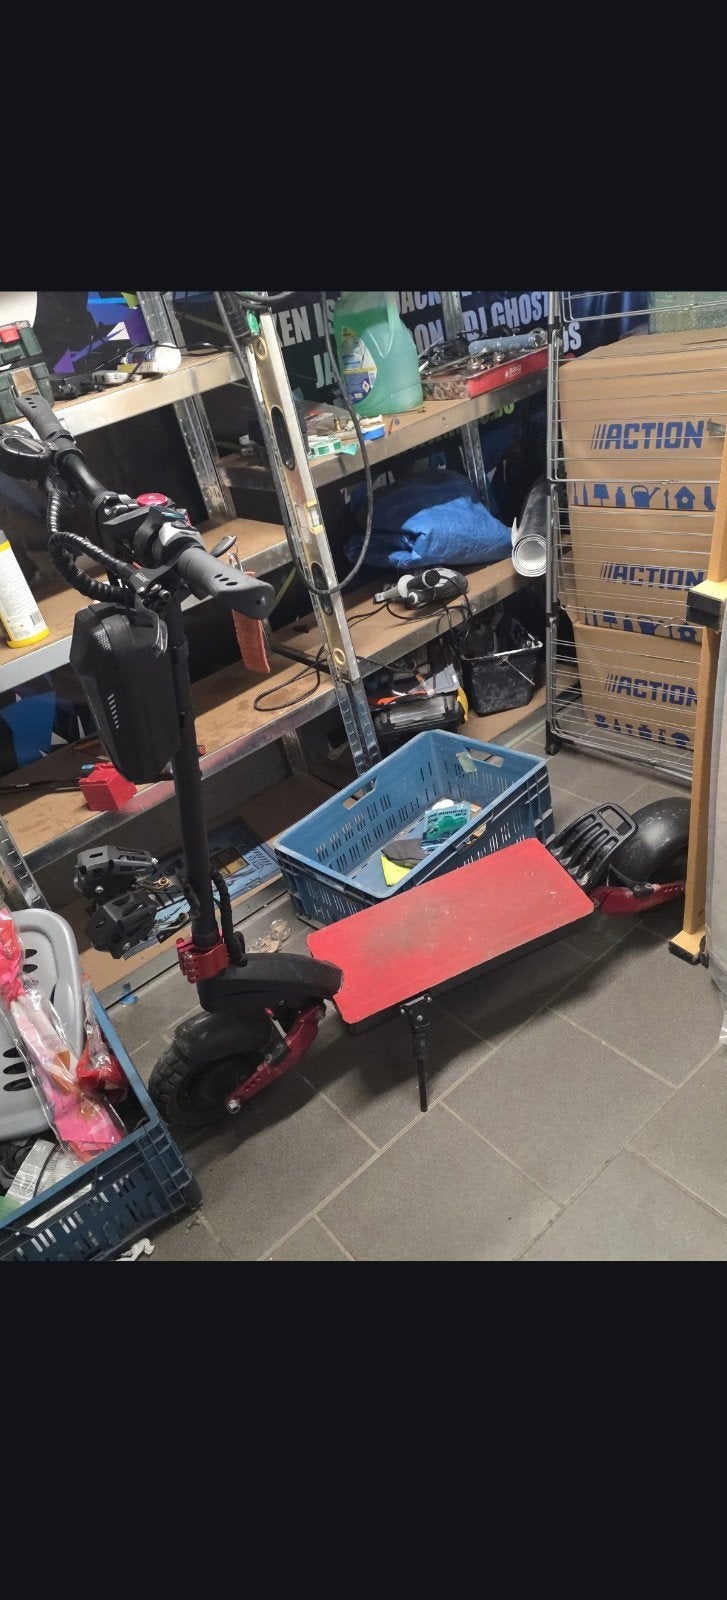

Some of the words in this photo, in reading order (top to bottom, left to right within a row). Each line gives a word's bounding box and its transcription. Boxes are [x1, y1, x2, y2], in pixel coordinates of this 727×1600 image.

[491, 291, 549, 329] GHOST
[604, 421, 704, 449] ACTION
[612, 563, 704, 591] ACTION
[616, 676, 698, 707] ACTION
